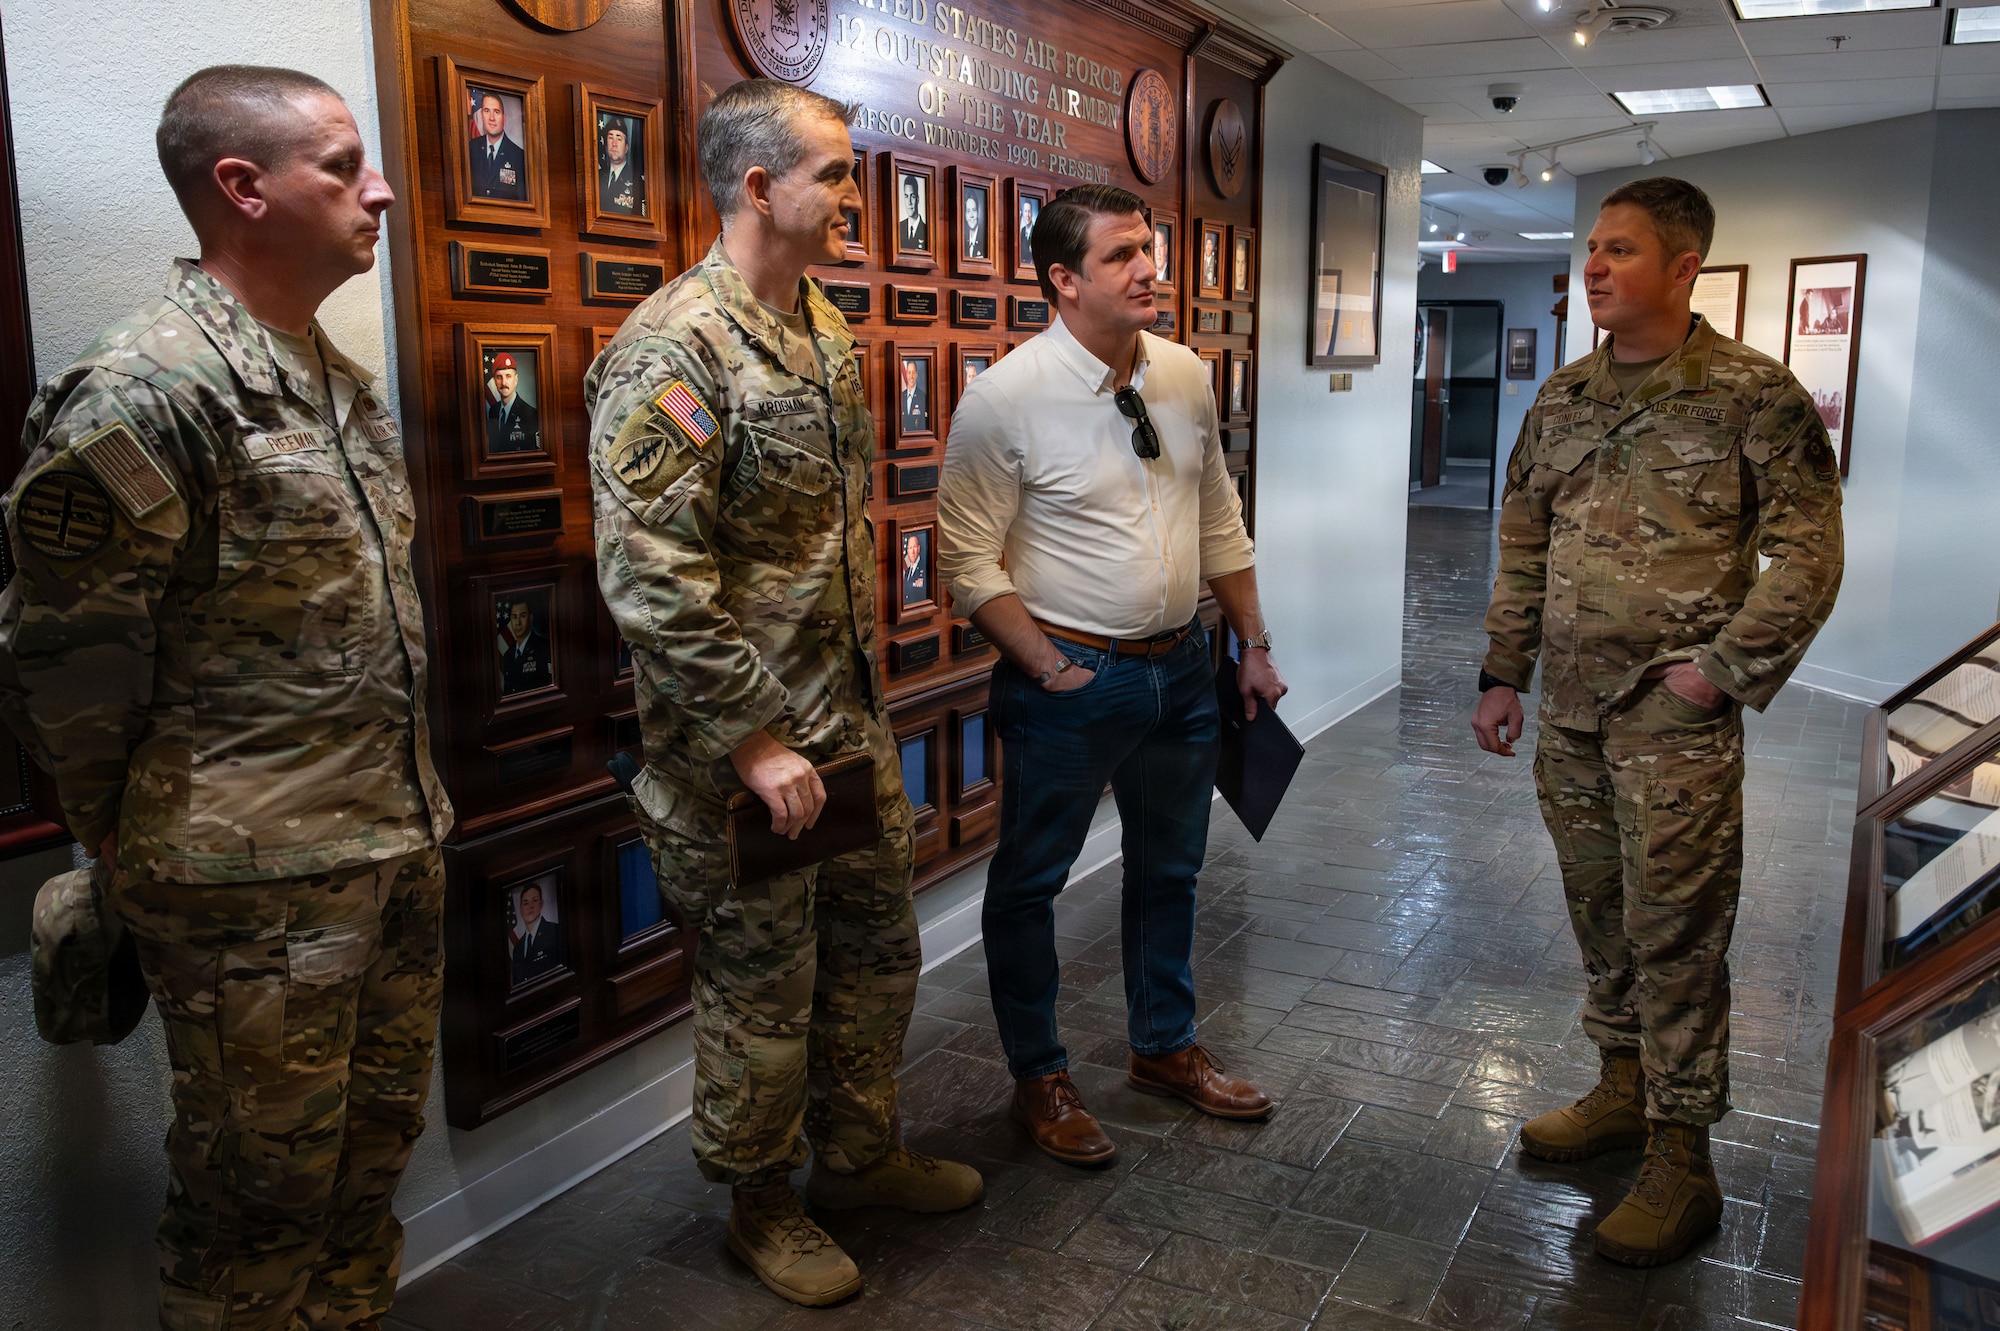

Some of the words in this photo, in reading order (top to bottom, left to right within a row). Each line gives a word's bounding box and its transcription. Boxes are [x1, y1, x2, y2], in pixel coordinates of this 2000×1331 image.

[748, 27, 767, 59] UNITED
[767, 58, 791, 77] STATES
[792, 68, 801, 77] OF
[802, 44, 822, 73] AMERICA
[836, 14, 865, 52] 12
[876, 26, 1039, 105] OUTSTANDING
[1046, 83, 1119, 130] AIRMEN
[934, 2, 1018, 59] STATES
[1023, 37, 1058, 74] AIR
[1065, 51, 1123, 97] FORCE
[918, 81, 950, 118] OF
[958, 92, 1005, 134] THE
[1012, 108, 1068, 150] YEAR
[852, 106, 917, 140] AFSOC
[923, 121, 1000, 161] WINNERS
[1006, 143, 1039, 169] 1990
[1049, 153, 1111, 185] PRESENT
[758, 398, 807, 417] KROGMAN
[1669, 402, 1690, 417] AIR
[1690, 404, 1726, 421] FORCE
[264, 431, 320, 453] FREEMAN
[651, 417, 684, 449] AIRBORNE
